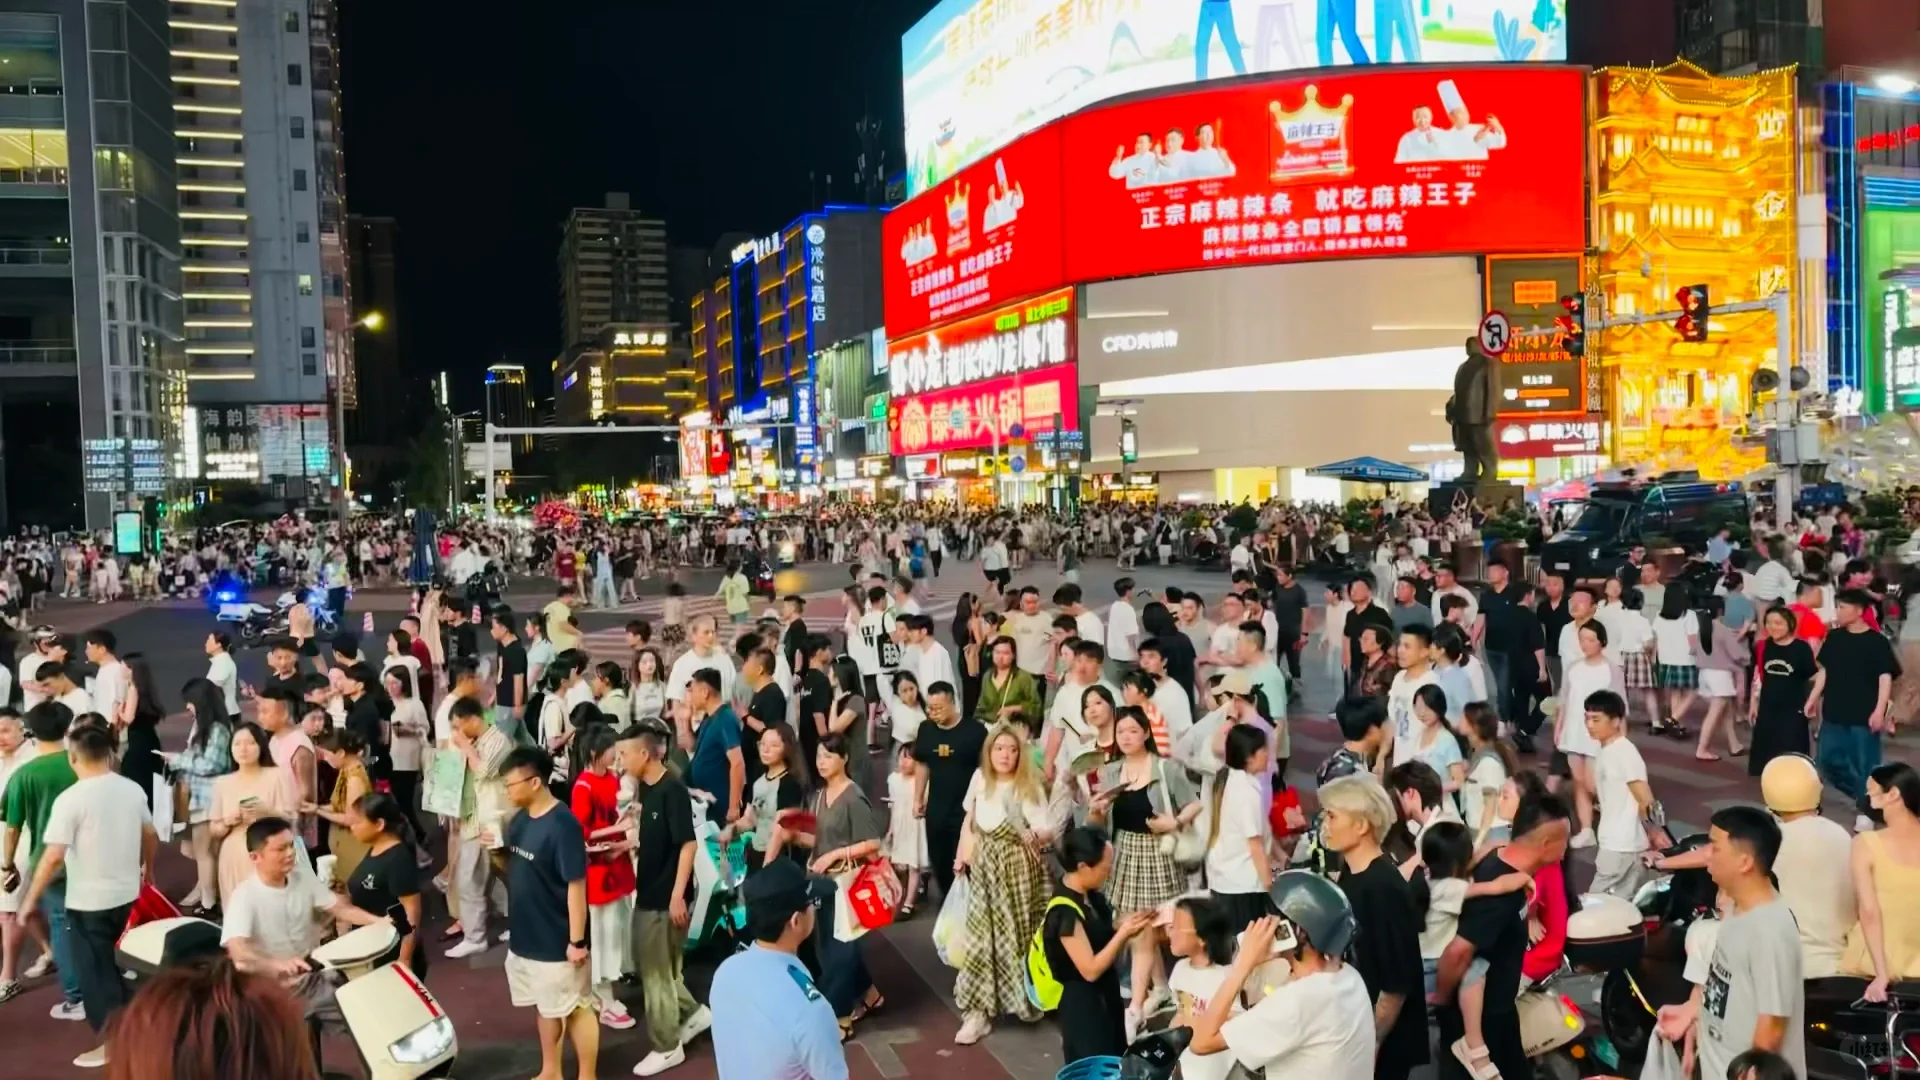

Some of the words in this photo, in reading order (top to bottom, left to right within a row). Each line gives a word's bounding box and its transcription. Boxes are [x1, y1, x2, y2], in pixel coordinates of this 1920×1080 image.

[1140, 192, 1292, 230] 正宗麻辣辣条
[1316, 181, 1477, 213] 就吃麻辣王子
[811, 247, 826, 322] 漫心酒店
